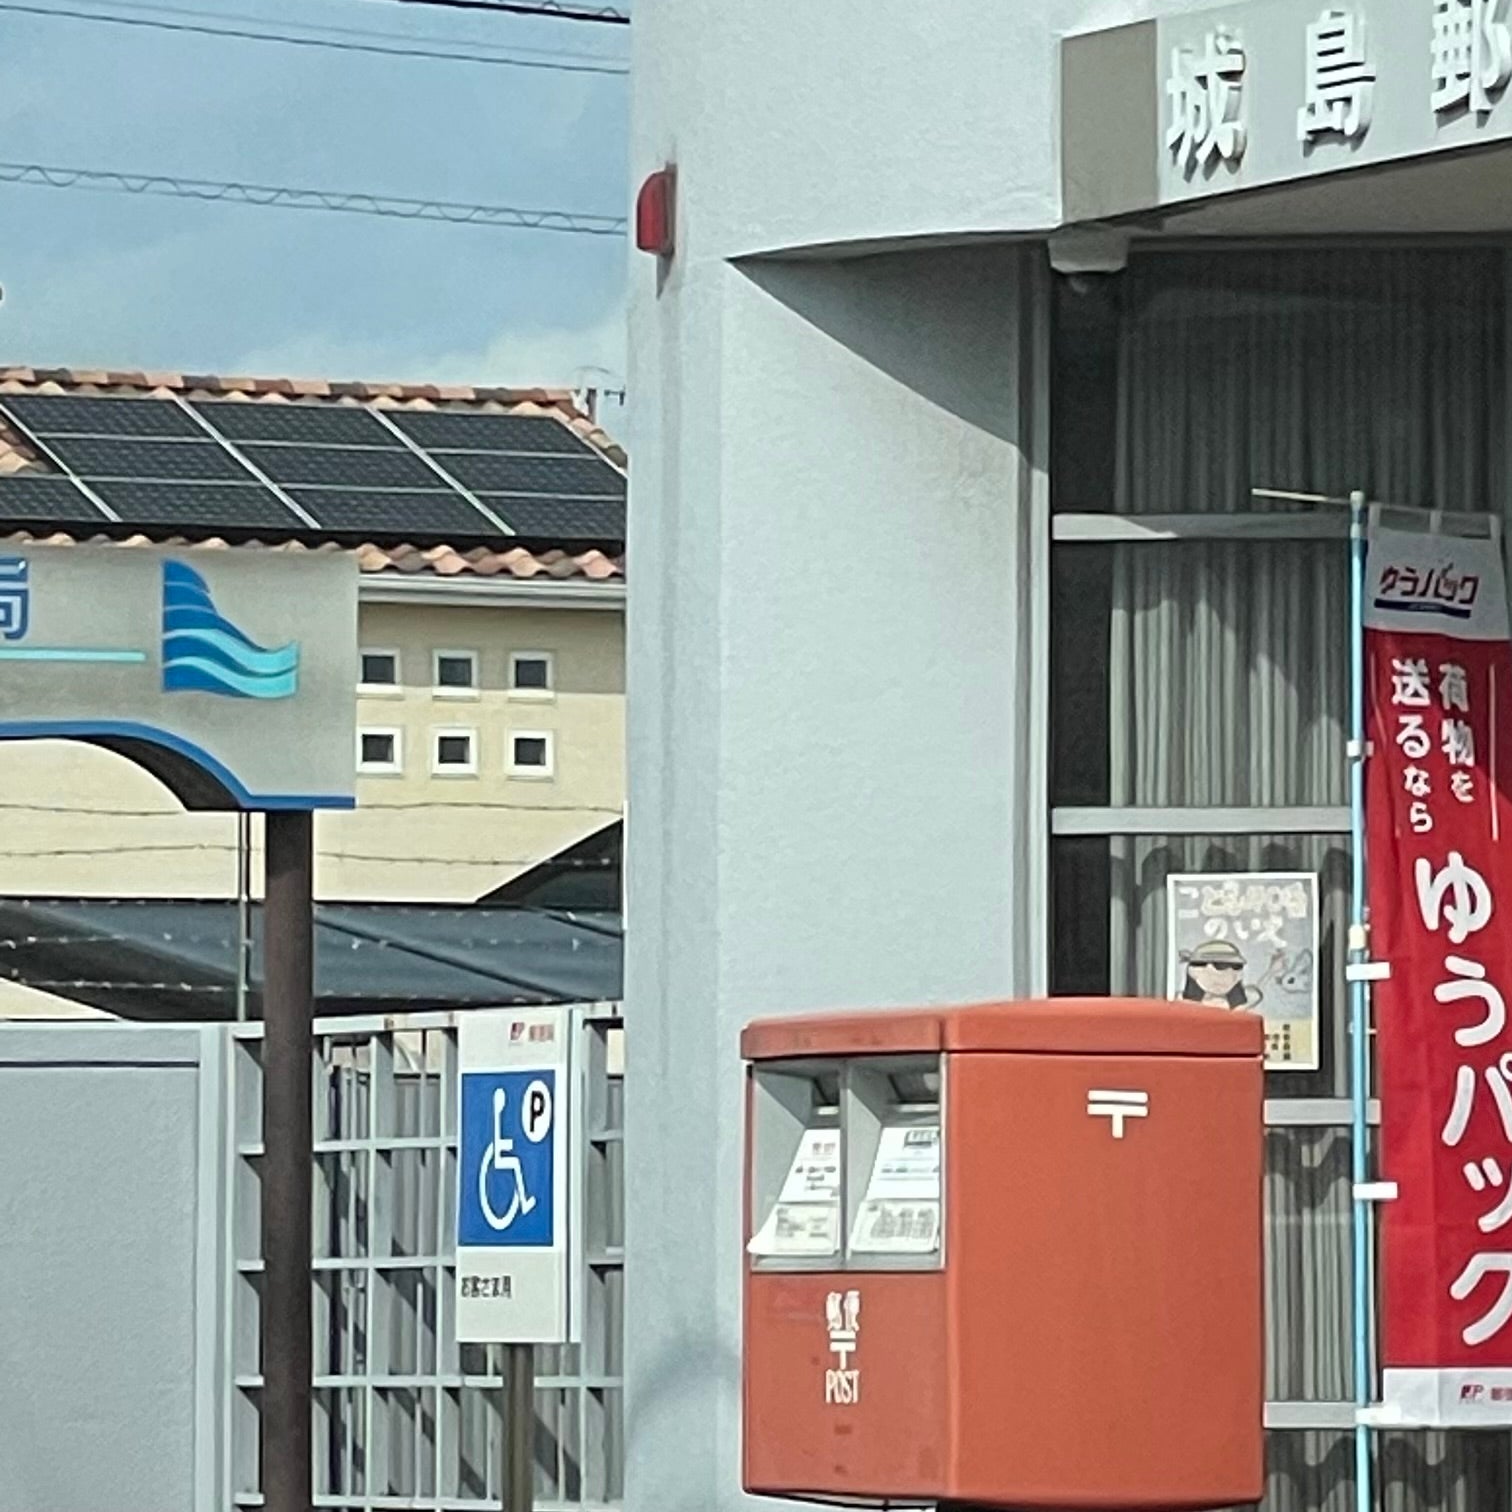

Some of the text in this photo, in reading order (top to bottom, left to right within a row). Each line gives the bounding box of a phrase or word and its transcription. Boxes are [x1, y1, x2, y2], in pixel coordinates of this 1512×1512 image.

[1391, 657, 1433, 833] 送るなら
[1438, 662, 1475, 803] 荷物を
[529, 1091, 545, 1133] P
[825, 1368, 860, 1404] POST
